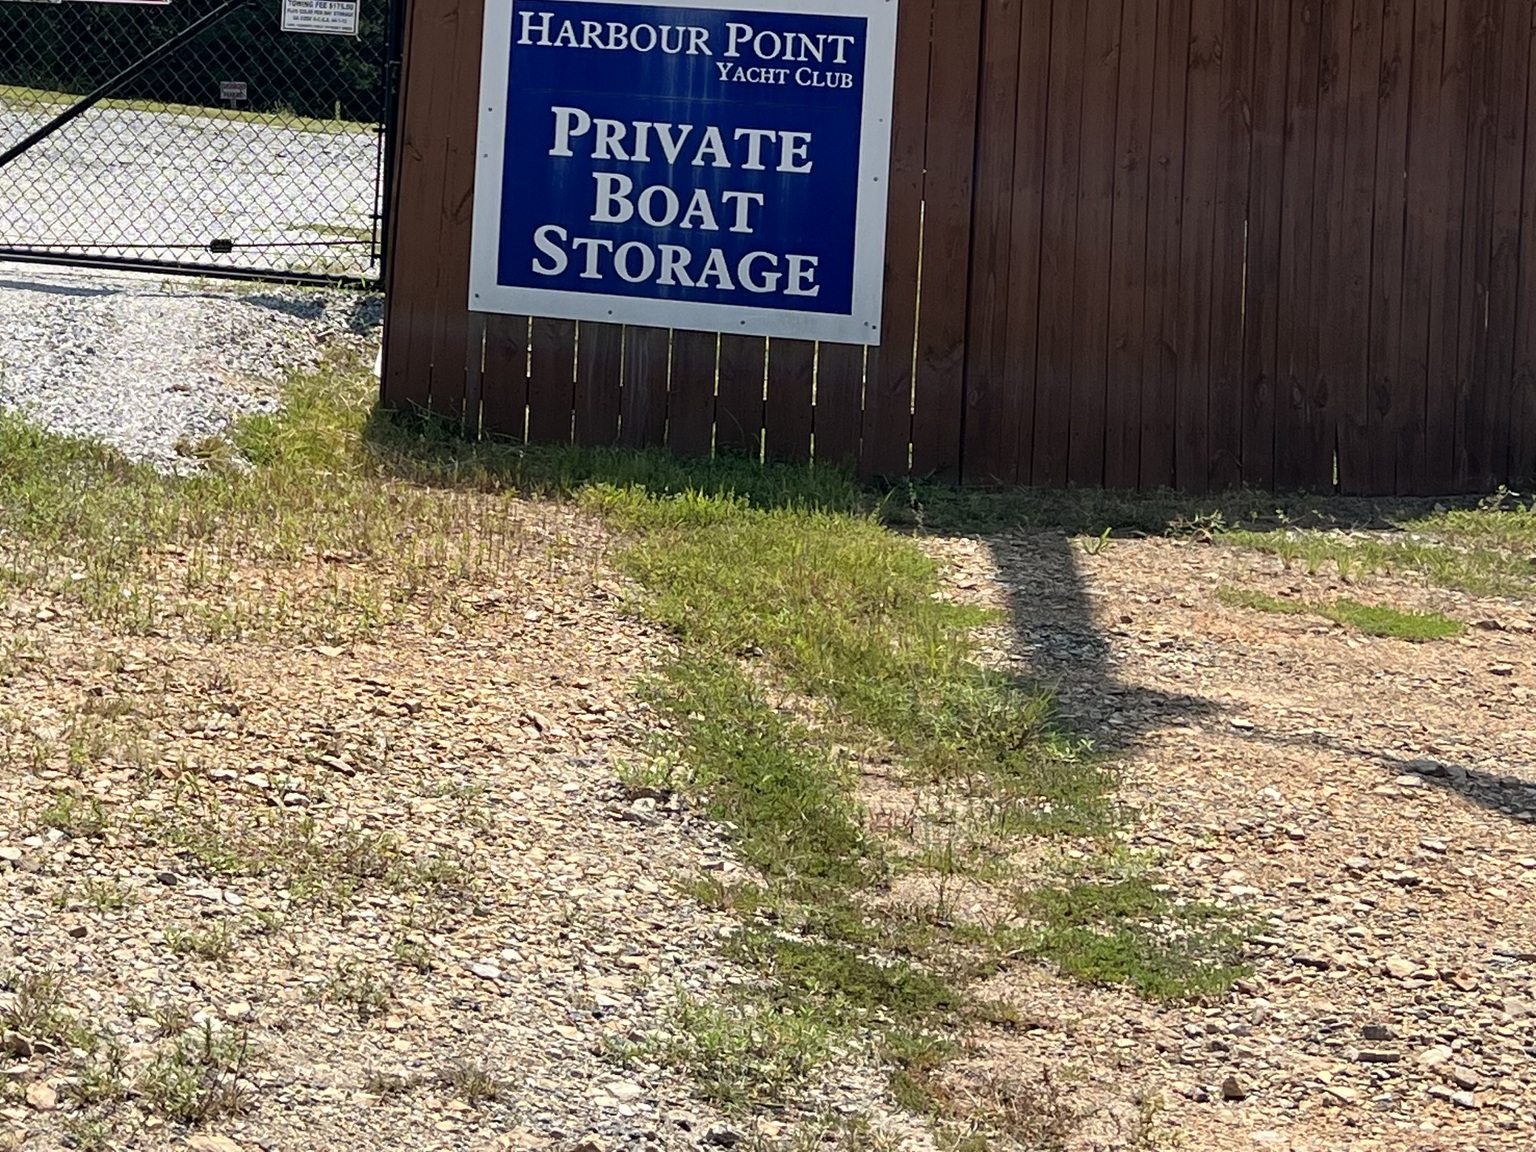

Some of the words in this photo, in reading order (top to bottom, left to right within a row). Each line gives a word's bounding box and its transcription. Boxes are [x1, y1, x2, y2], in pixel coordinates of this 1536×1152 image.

[288, 0, 314, 8] TOWING
[315, 1, 328, 9] FEE
[517, 11, 712, 56] HARBOUR
[723, 22, 855, 64] POINT
[716, 62, 790, 85] YACHT
[794, 67, 853, 88] CLUB
[549, 106, 813, 173] PRIVATE
[590, 172, 764, 233] BOAT
[532, 225, 820, 297] STORAGE
